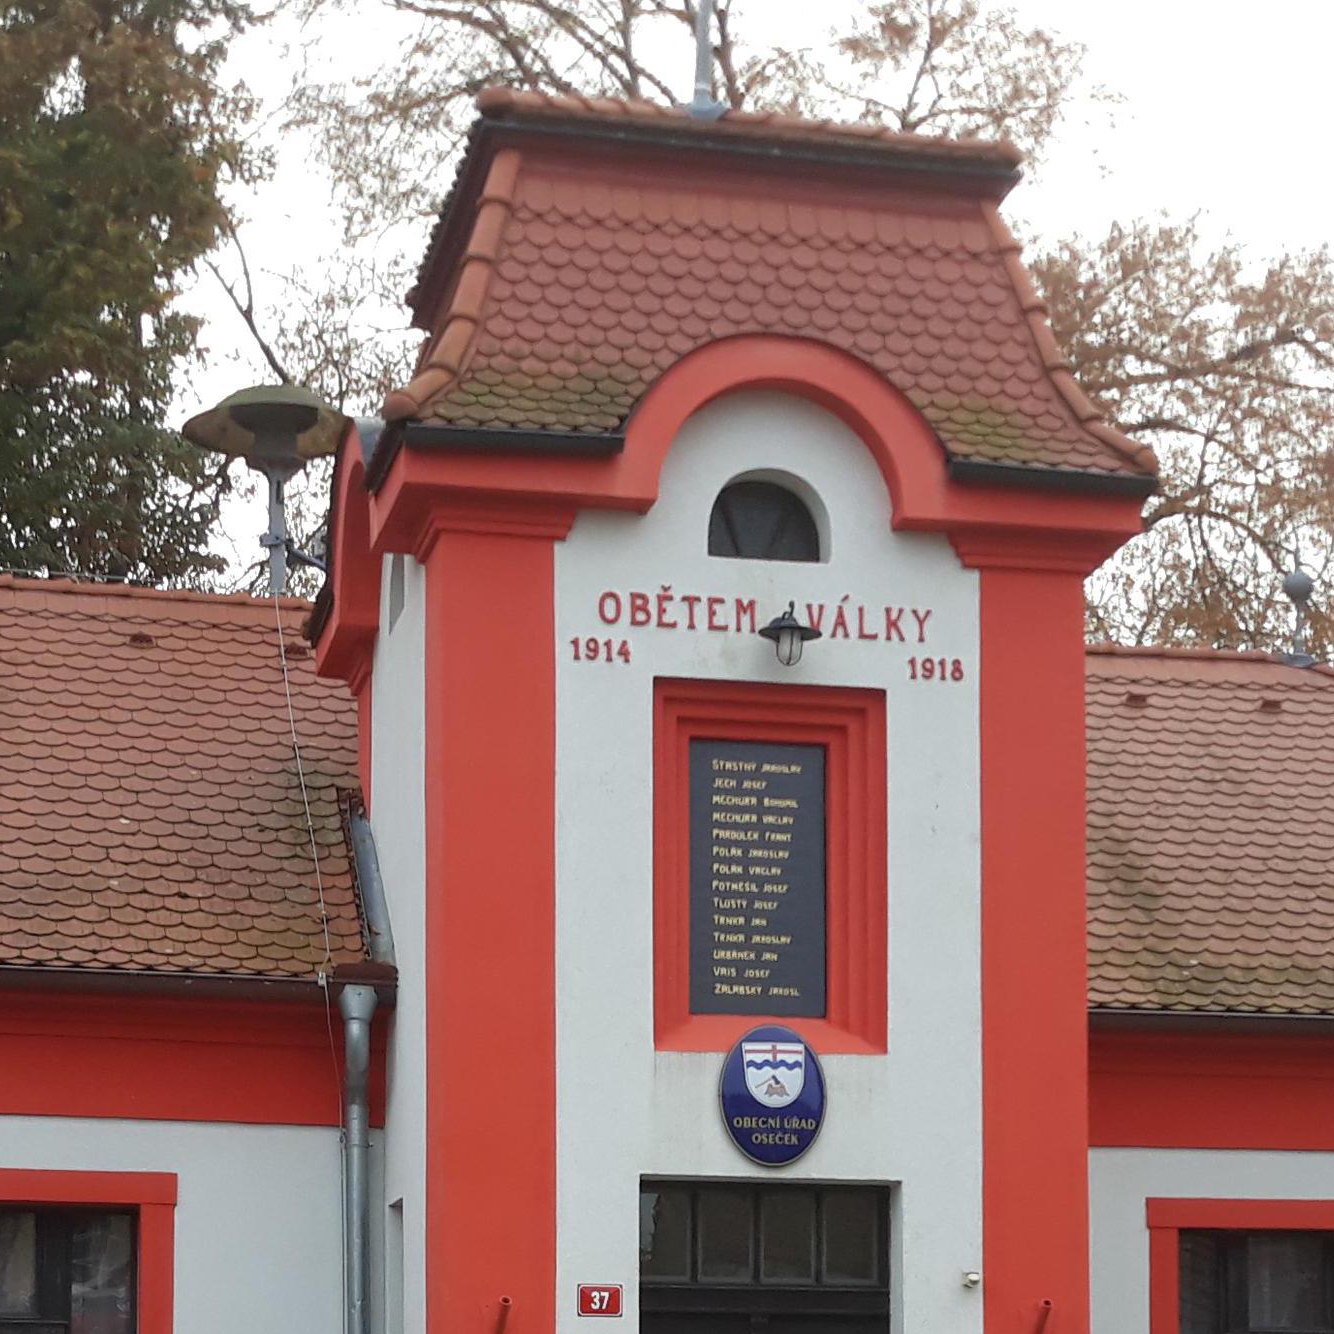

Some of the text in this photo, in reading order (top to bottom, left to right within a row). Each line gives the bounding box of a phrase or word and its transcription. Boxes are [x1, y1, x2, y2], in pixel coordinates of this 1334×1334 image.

[597, 585, 933, 643] OBĚTEM VÁLKY
[570, 637, 631, 663] 1914
[908, 657, 964, 681] 1918
[733, 1116, 780, 1128] OBECNÍ
[752, 1131, 799, 1145] OSEČEK
[591, 1291, 609, 1309] 37
